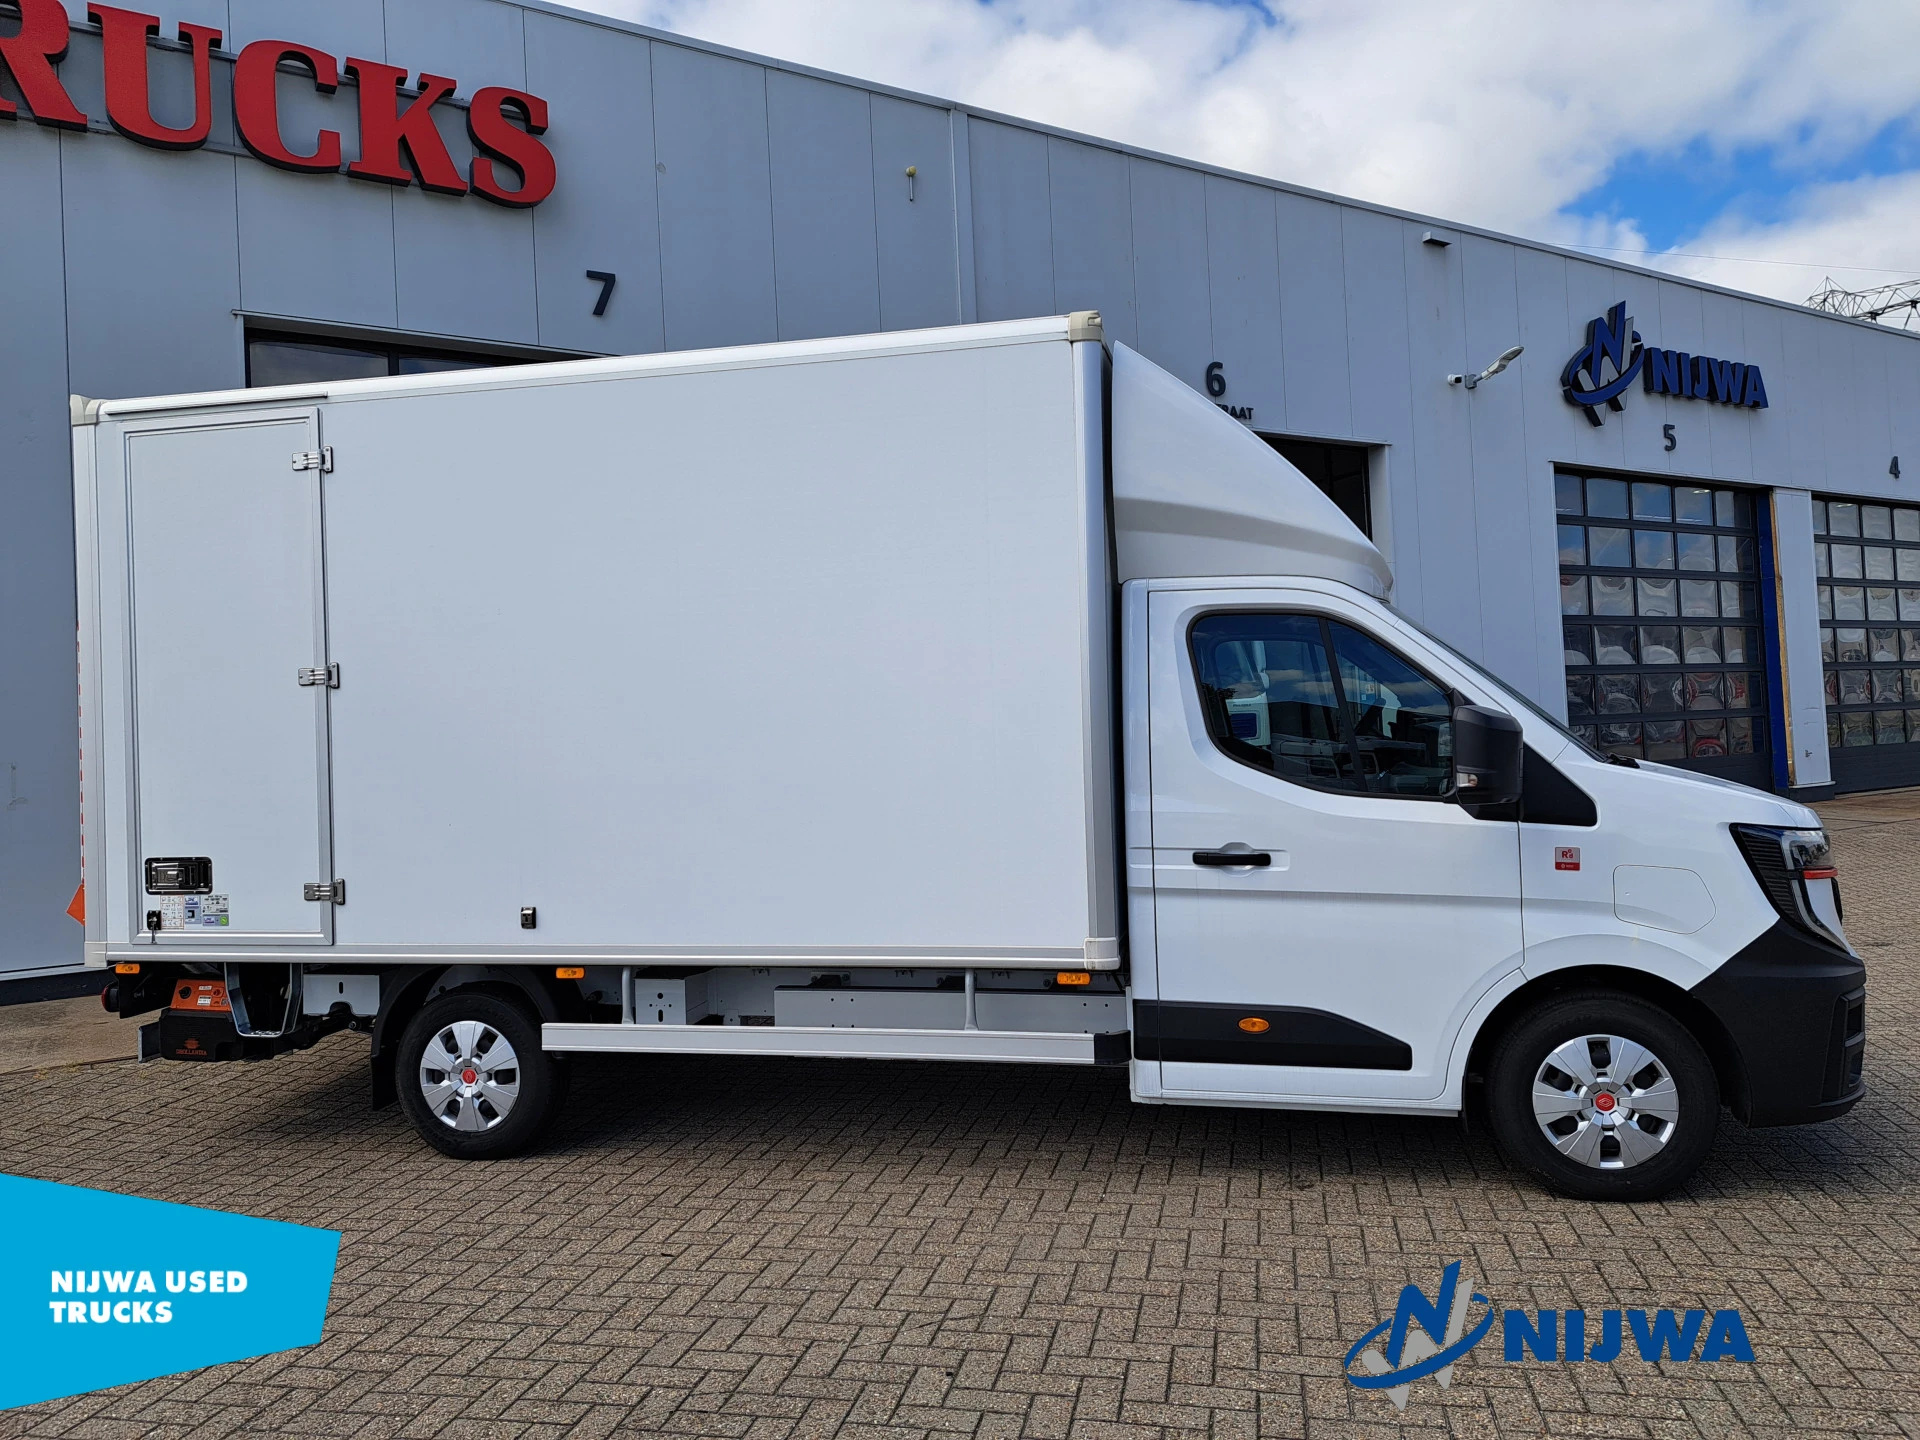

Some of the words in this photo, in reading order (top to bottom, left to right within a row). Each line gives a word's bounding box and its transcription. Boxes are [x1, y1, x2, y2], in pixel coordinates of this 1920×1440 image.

[586, 269, 616, 316] 7
[1206, 361, 1226, 397] 6
[1643, 347, 1769, 409] NIJWA
[1663, 423, 1677, 451] 5
[1889, 455, 1901, 479] 4
